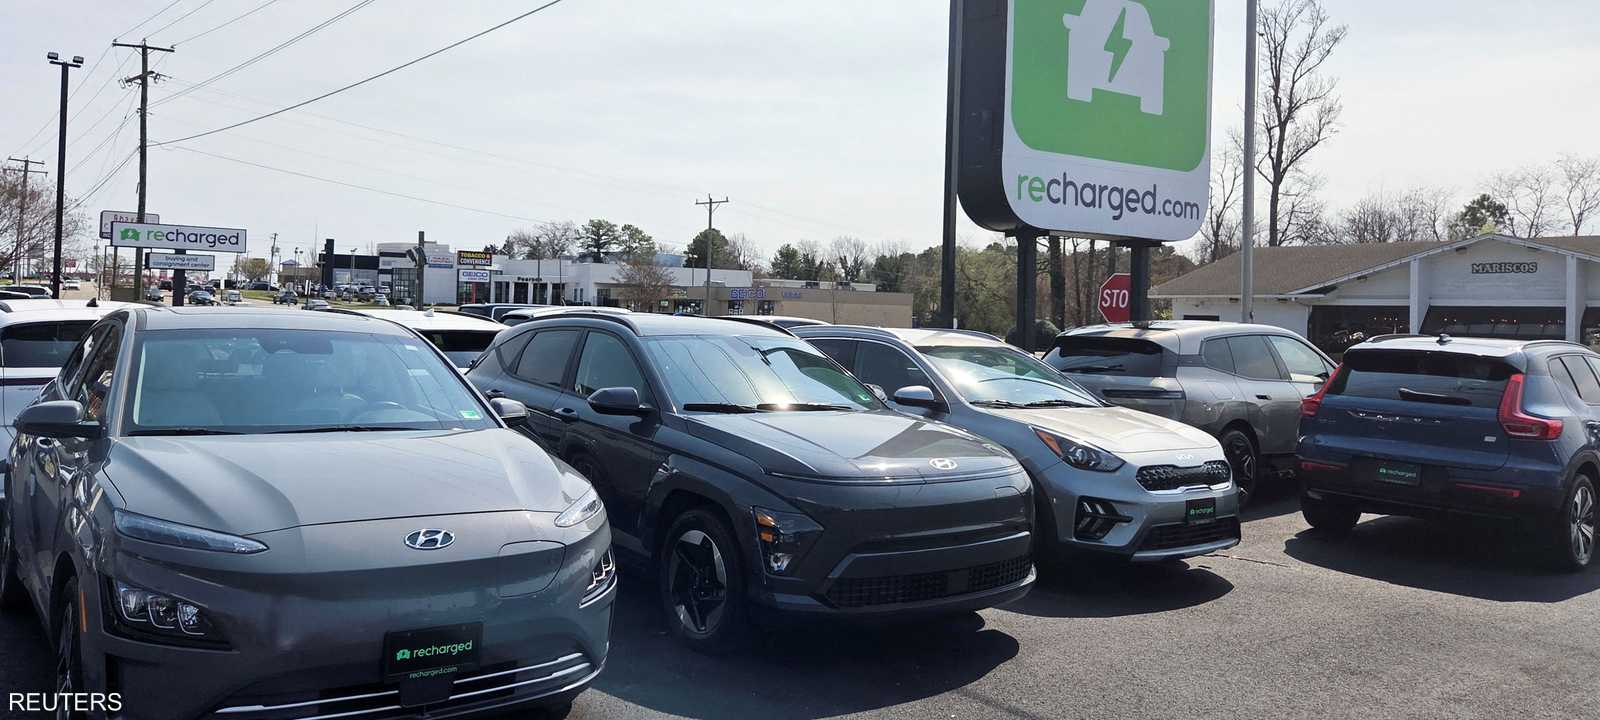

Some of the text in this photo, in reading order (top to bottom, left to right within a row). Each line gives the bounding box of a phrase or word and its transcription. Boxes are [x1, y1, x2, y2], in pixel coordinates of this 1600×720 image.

[1017, 172, 1200, 221] recharged.com
[146, 228, 239, 247] recharged
[1471, 262, 1538, 274] MARISCOS
[1101, 289, 1129, 308] STO
[413, 640, 473, 658] recharged
[409, 666, 458, 679] recharged.com
